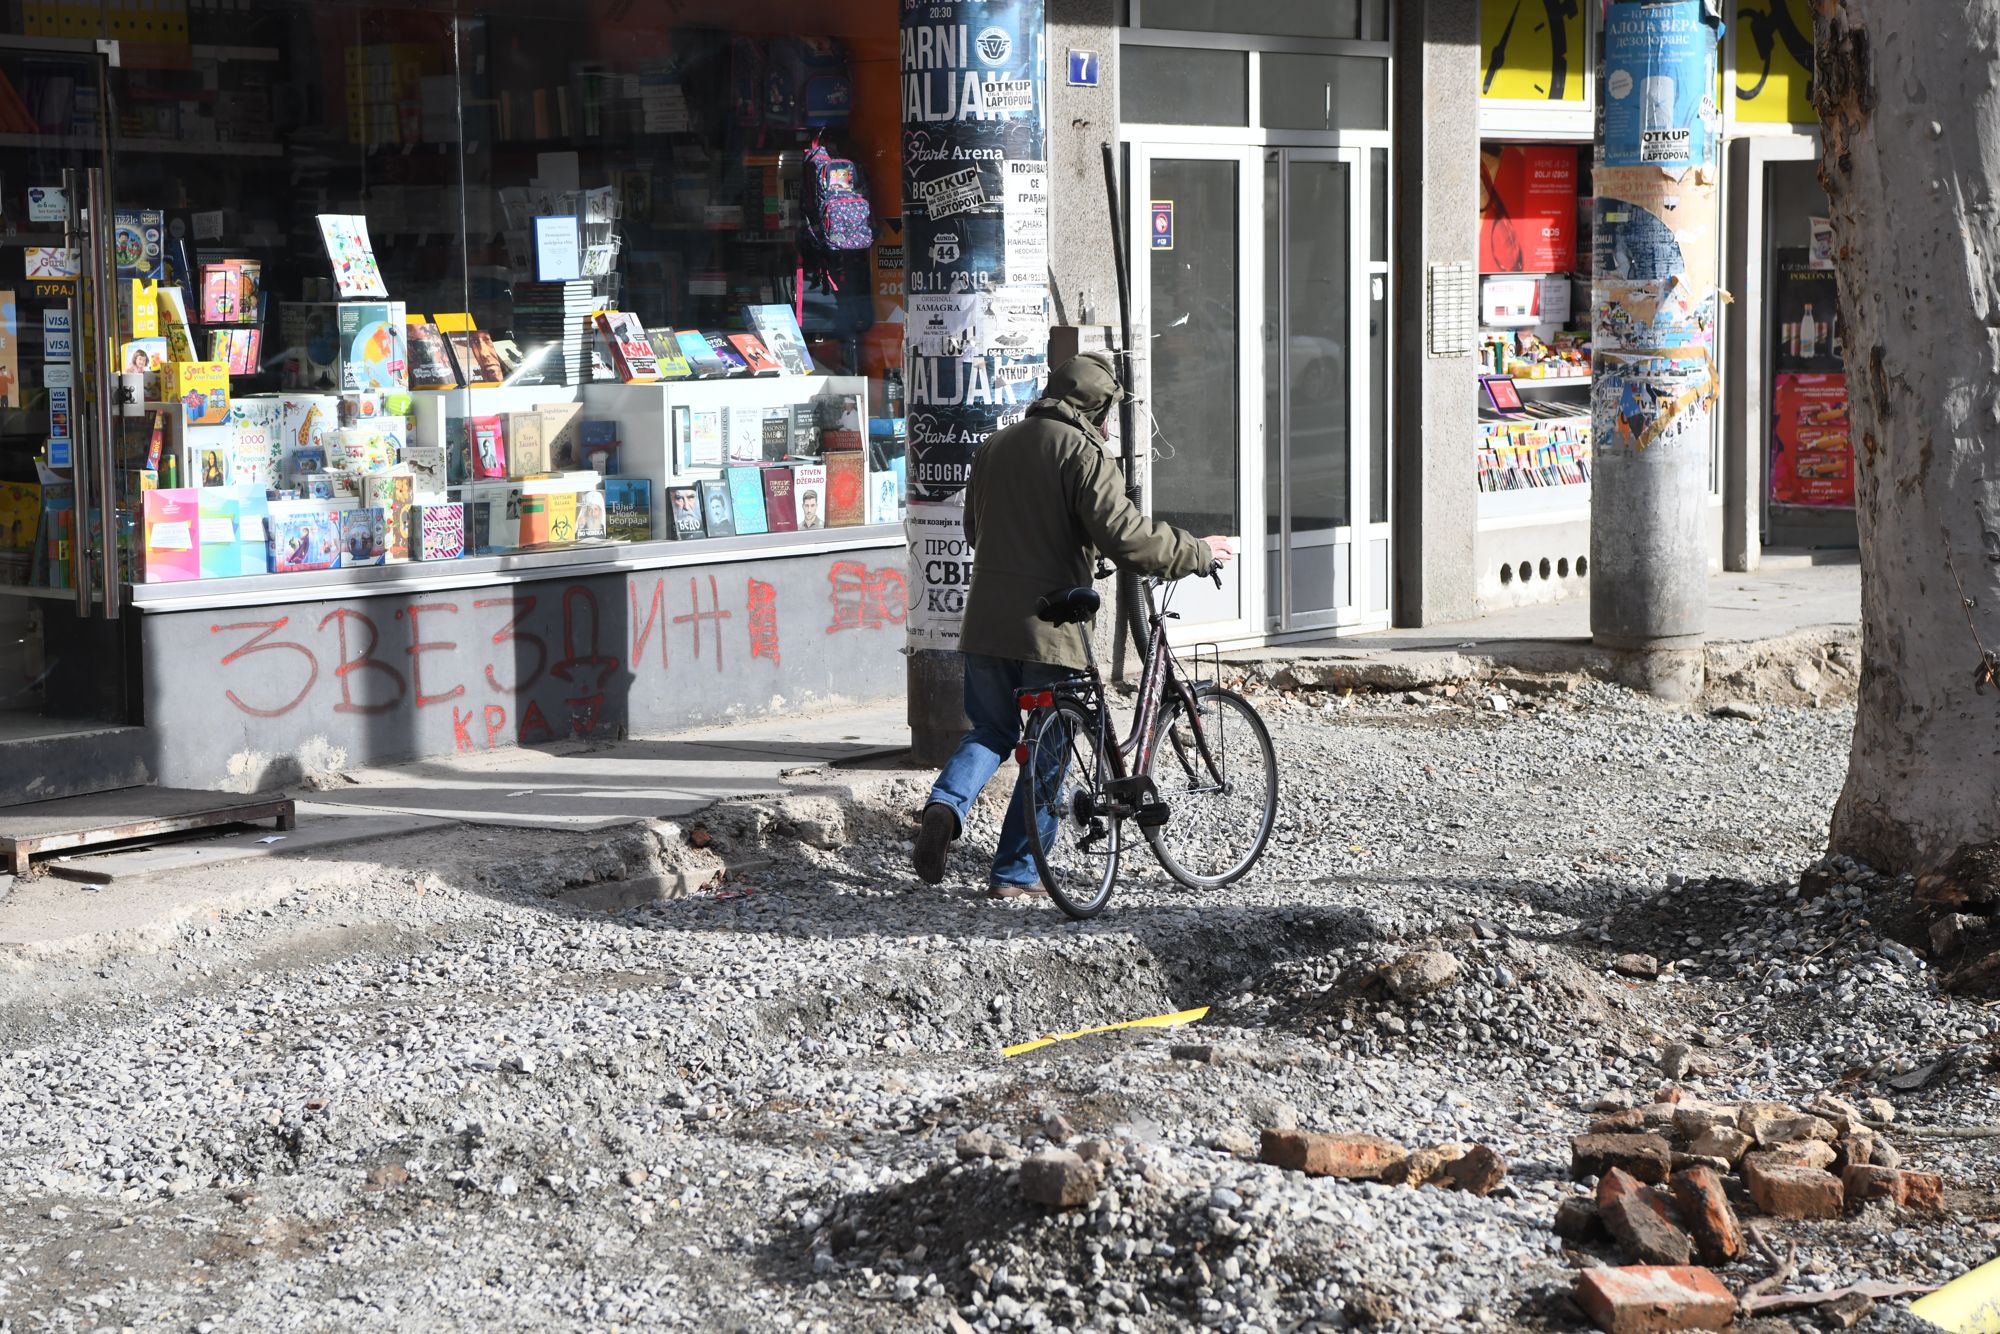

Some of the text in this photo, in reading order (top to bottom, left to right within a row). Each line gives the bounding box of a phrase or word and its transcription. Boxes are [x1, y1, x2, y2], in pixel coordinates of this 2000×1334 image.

[930, 7, 952, 18] 20:30
[1609, 19, 1698, 35] АЛОЈА ВЕРА
[1616, 33, 1691, 49] дезодоранс
[900, 25, 968, 72] PARNI
[1079, 52, 1090, 81] 7
[985, 81, 1031, 93] OTKUP
[986, 95, 1032, 107] LAPTOPOVA
[1643, 130, 1689, 142] OTKUP
[907, 140, 1004, 162] Stark Arena
[1642, 151, 1690, 161] LAPTOPOVA
[926, 170, 976, 195] OTKUP
[1030, 179, 1039, 188] СЕ
[930, 195, 985, 219] LAPTOPOVA
[936, 246, 955, 260] 44
[911, 272, 946, 291] 09.11.
[36, 284, 75, 296] ГУРАЈ
[916, 304, 961, 312] KAMAGRA
[48, 316, 69, 326] VISA
[49, 340, 70, 350] VISA
[998, 366, 1028, 380] OTKUP
[239, 435, 265, 445] 1000
[913, 424, 991, 445] Stark Are
[796, 477, 825, 485] DŽERARD
[610, 501, 634, 513] Тајна
[609, 516, 647, 527] Београда
[927, 588, 969, 613] КО
